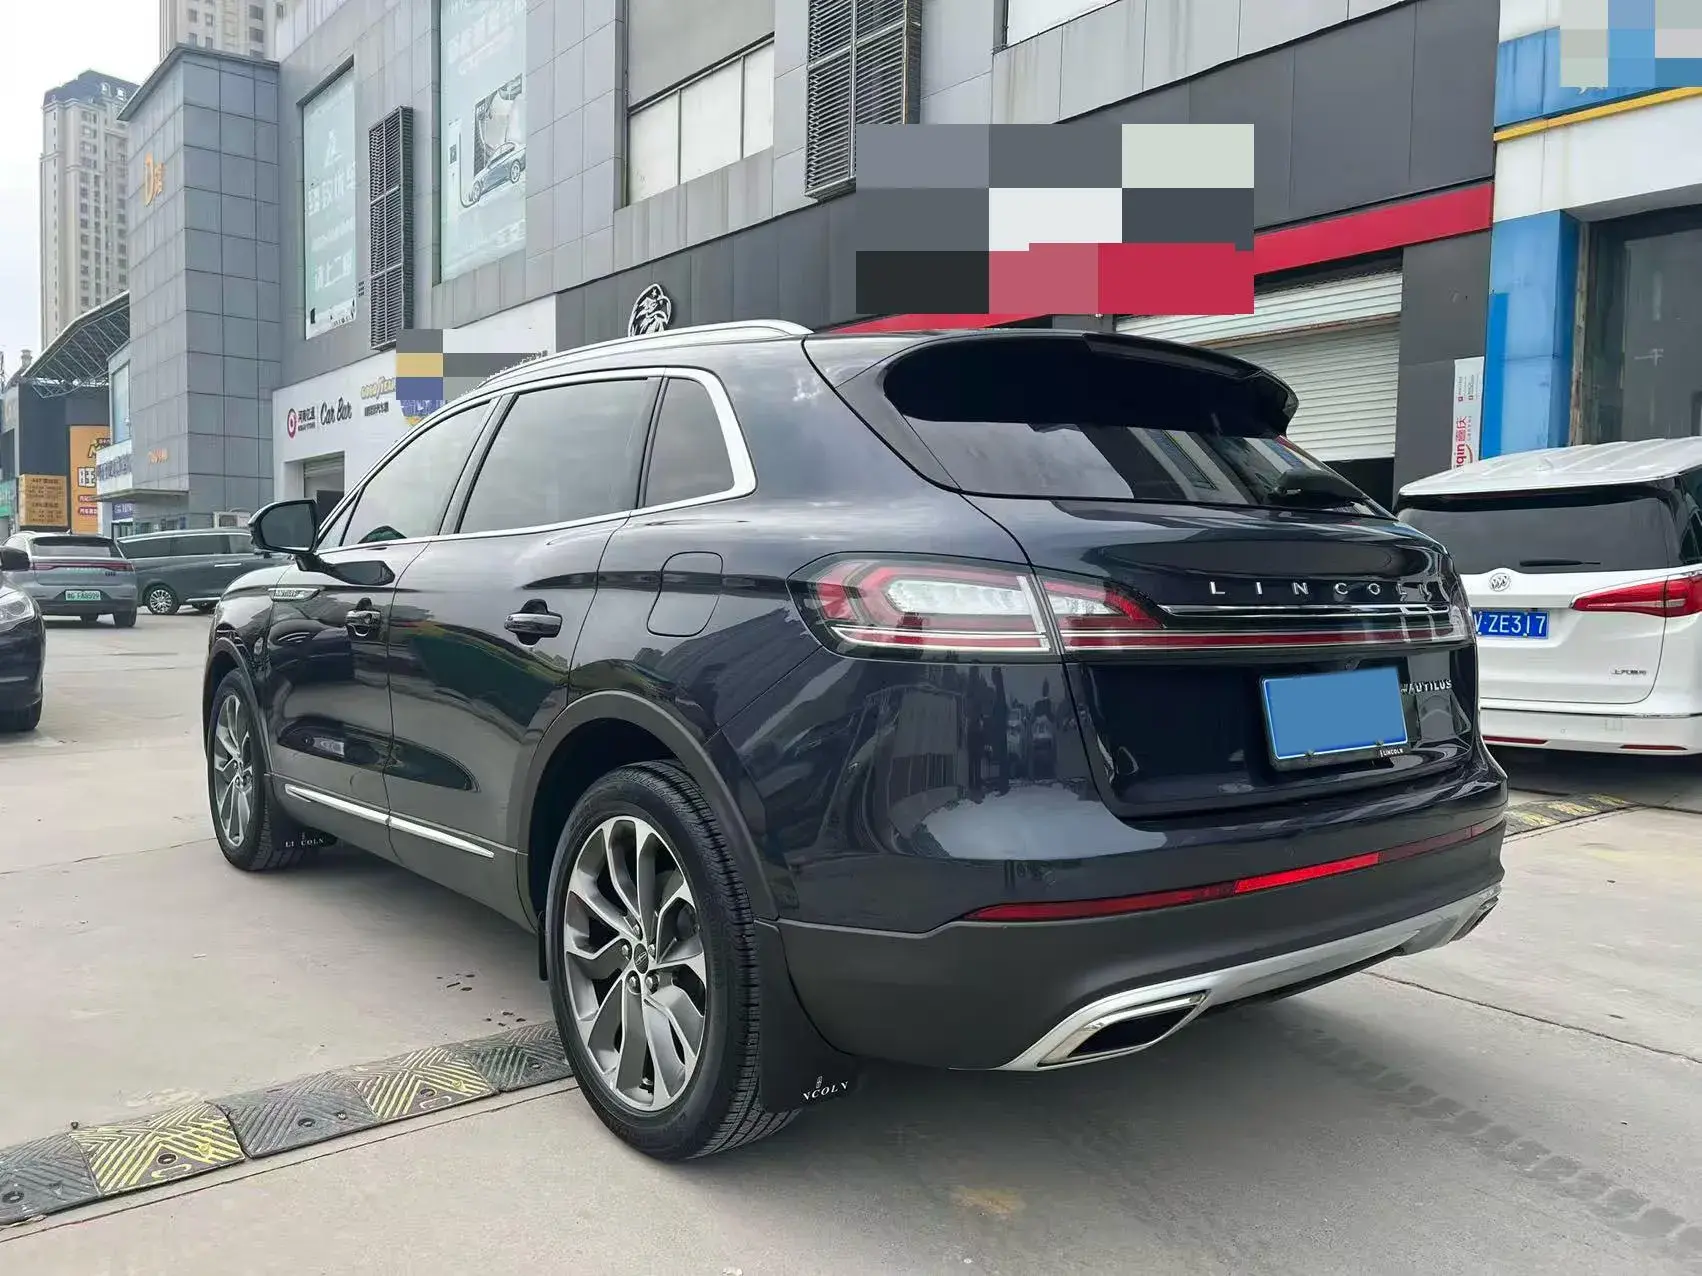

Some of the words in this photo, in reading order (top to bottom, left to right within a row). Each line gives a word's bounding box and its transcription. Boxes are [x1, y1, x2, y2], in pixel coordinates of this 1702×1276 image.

[320, 401, 335, 426] Car
[337, 396, 352, 422] Bar
[1209, 581, 1428, 597] LINCOLN
